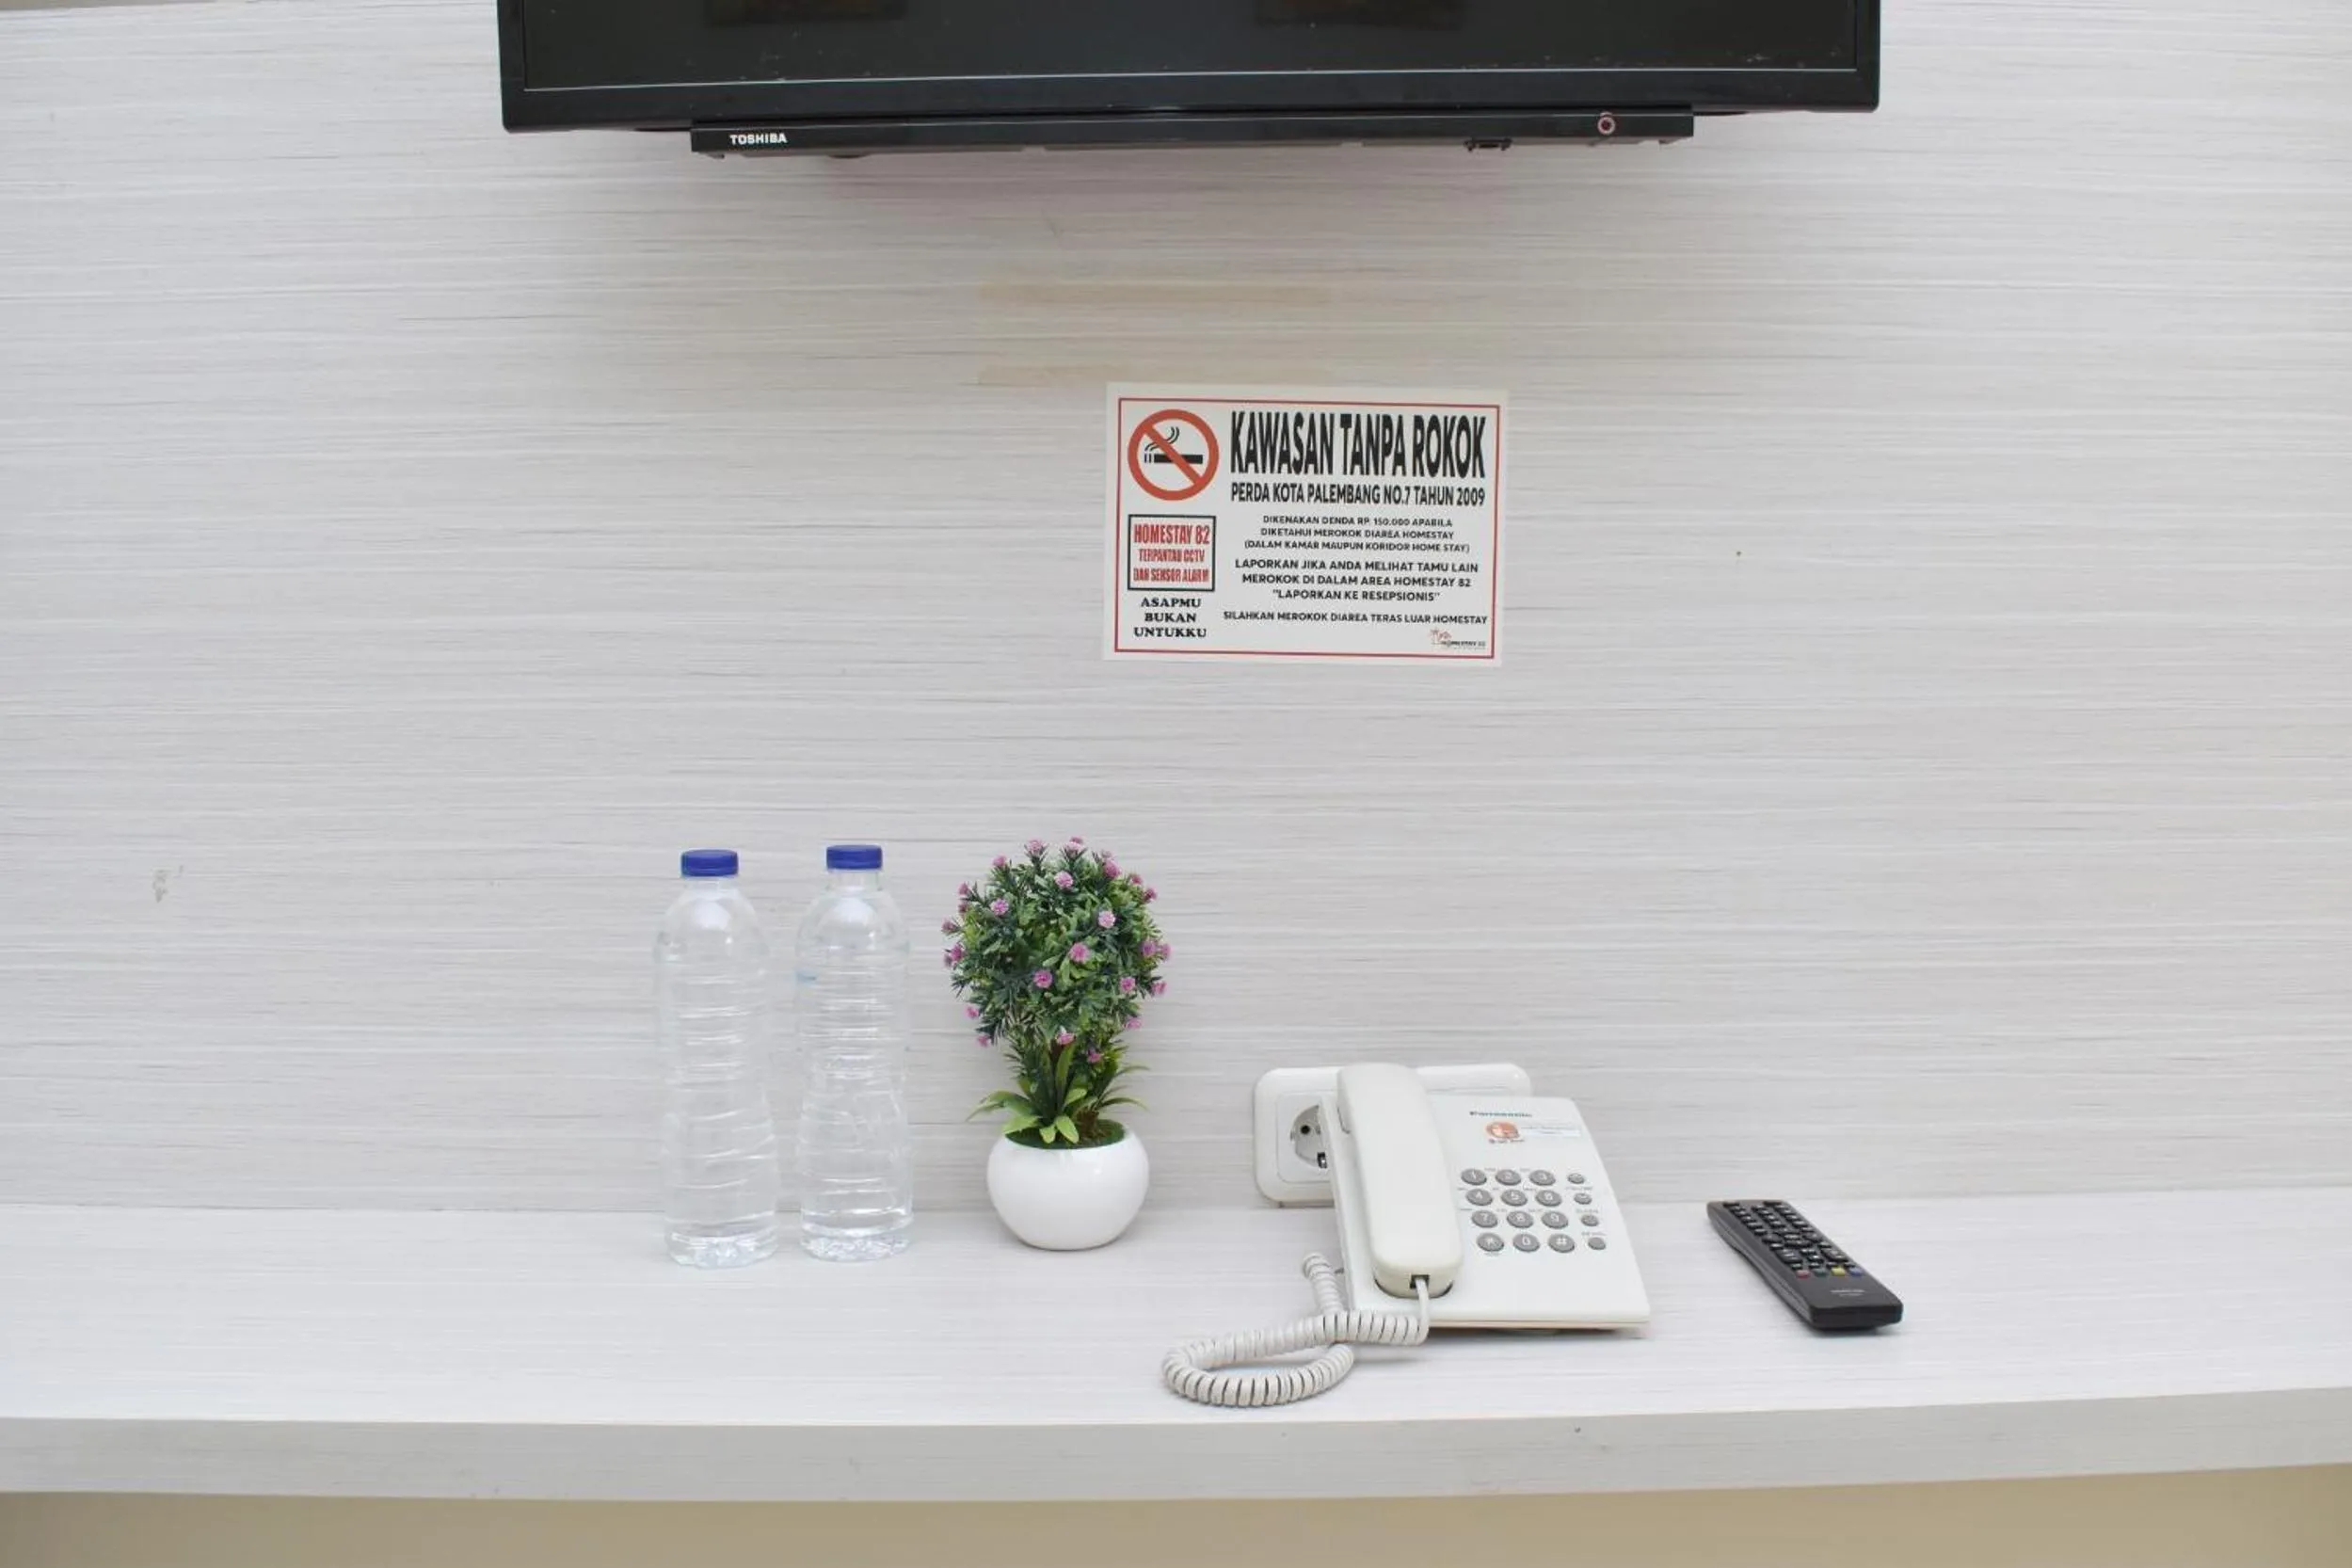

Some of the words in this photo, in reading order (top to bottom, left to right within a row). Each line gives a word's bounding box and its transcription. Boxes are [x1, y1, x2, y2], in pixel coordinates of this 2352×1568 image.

[729, 133, 788, 145] TOSHIBA
[1231, 410, 1335, 475] KAWASAN
[1340, 413, 1407, 476] TANPA
[1412, 414, 1486, 478] ROKOK
[1231, 482, 1270, 503] PERDA
[1272, 483, 1304, 504] KOTA
[1307, 484, 1381, 504] PALEMBANG
[1384, 486, 1411, 504] NO.7
[1413, 486, 1454, 505] TAHUN
[1456, 488, 1486, 506] 2009
[1263, 515, 1320, 524] DIKENAKAN
[1321, 516, 1355, 525] DENDA
[1373, 518, 1411, 527] 150.000
[1412, 518, 1453, 527] APABILA
[1133, 524, 1192, 544] HOMESTAY
[1195, 525, 1210, 545] 82
[1260, 527, 1312, 536] DIKETAHUI
[1314, 528, 1362, 537] MEROKOK
[1365, 530, 1400, 538] DIAREA
[1402, 531, 1454, 539] HOMESTAY
[1244, 539, 1282, 550] (DALAM
[1284, 540, 1320, 550] KAMAR
[1321, 541, 1364, 551] MAUPUN
[1366, 542, 1411, 552] KORIDOR
[1412, 543, 1441, 552] HOME
[1443, 544, 1470, 553] STAY)
[1235, 559, 1299, 568] LAPORKAN
[1302, 560, 1326, 569] JIKA
[1329, 560, 1362, 570] ANDA
[1365, 561, 1415, 571] MELIHAT
[1416, 563, 1449, 572] TAMU
[1451, 563, 1479, 573] LAIN
[1242, 573, 1300, 584] MEROKOK
[1303, 575, 1316, 584] DI
[1318, 575, 1359, 585] DALAM
[1360, 576, 1392, 586] AREA
[1394, 577, 1456, 587] HOMESTAY
[1458, 578, 1471, 587] 82
[1344, 590, 1359, 600] KE
[1141, 597, 1202, 608] ASAPMU
[1144, 613, 1197, 622] BUKAN
[1224, 611, 1275, 620] SILAHKAN
[1277, 612, 1328, 621] MEROKOK
[1330, 613, 1368, 622] DIAREA
[1370, 614, 1402, 623] TERAS
[1404, 615, 1432, 623] LUAR
[1433, 616, 1488, 624] HOMESTAY
[1133, 627, 1207, 637] UNTUKKU
